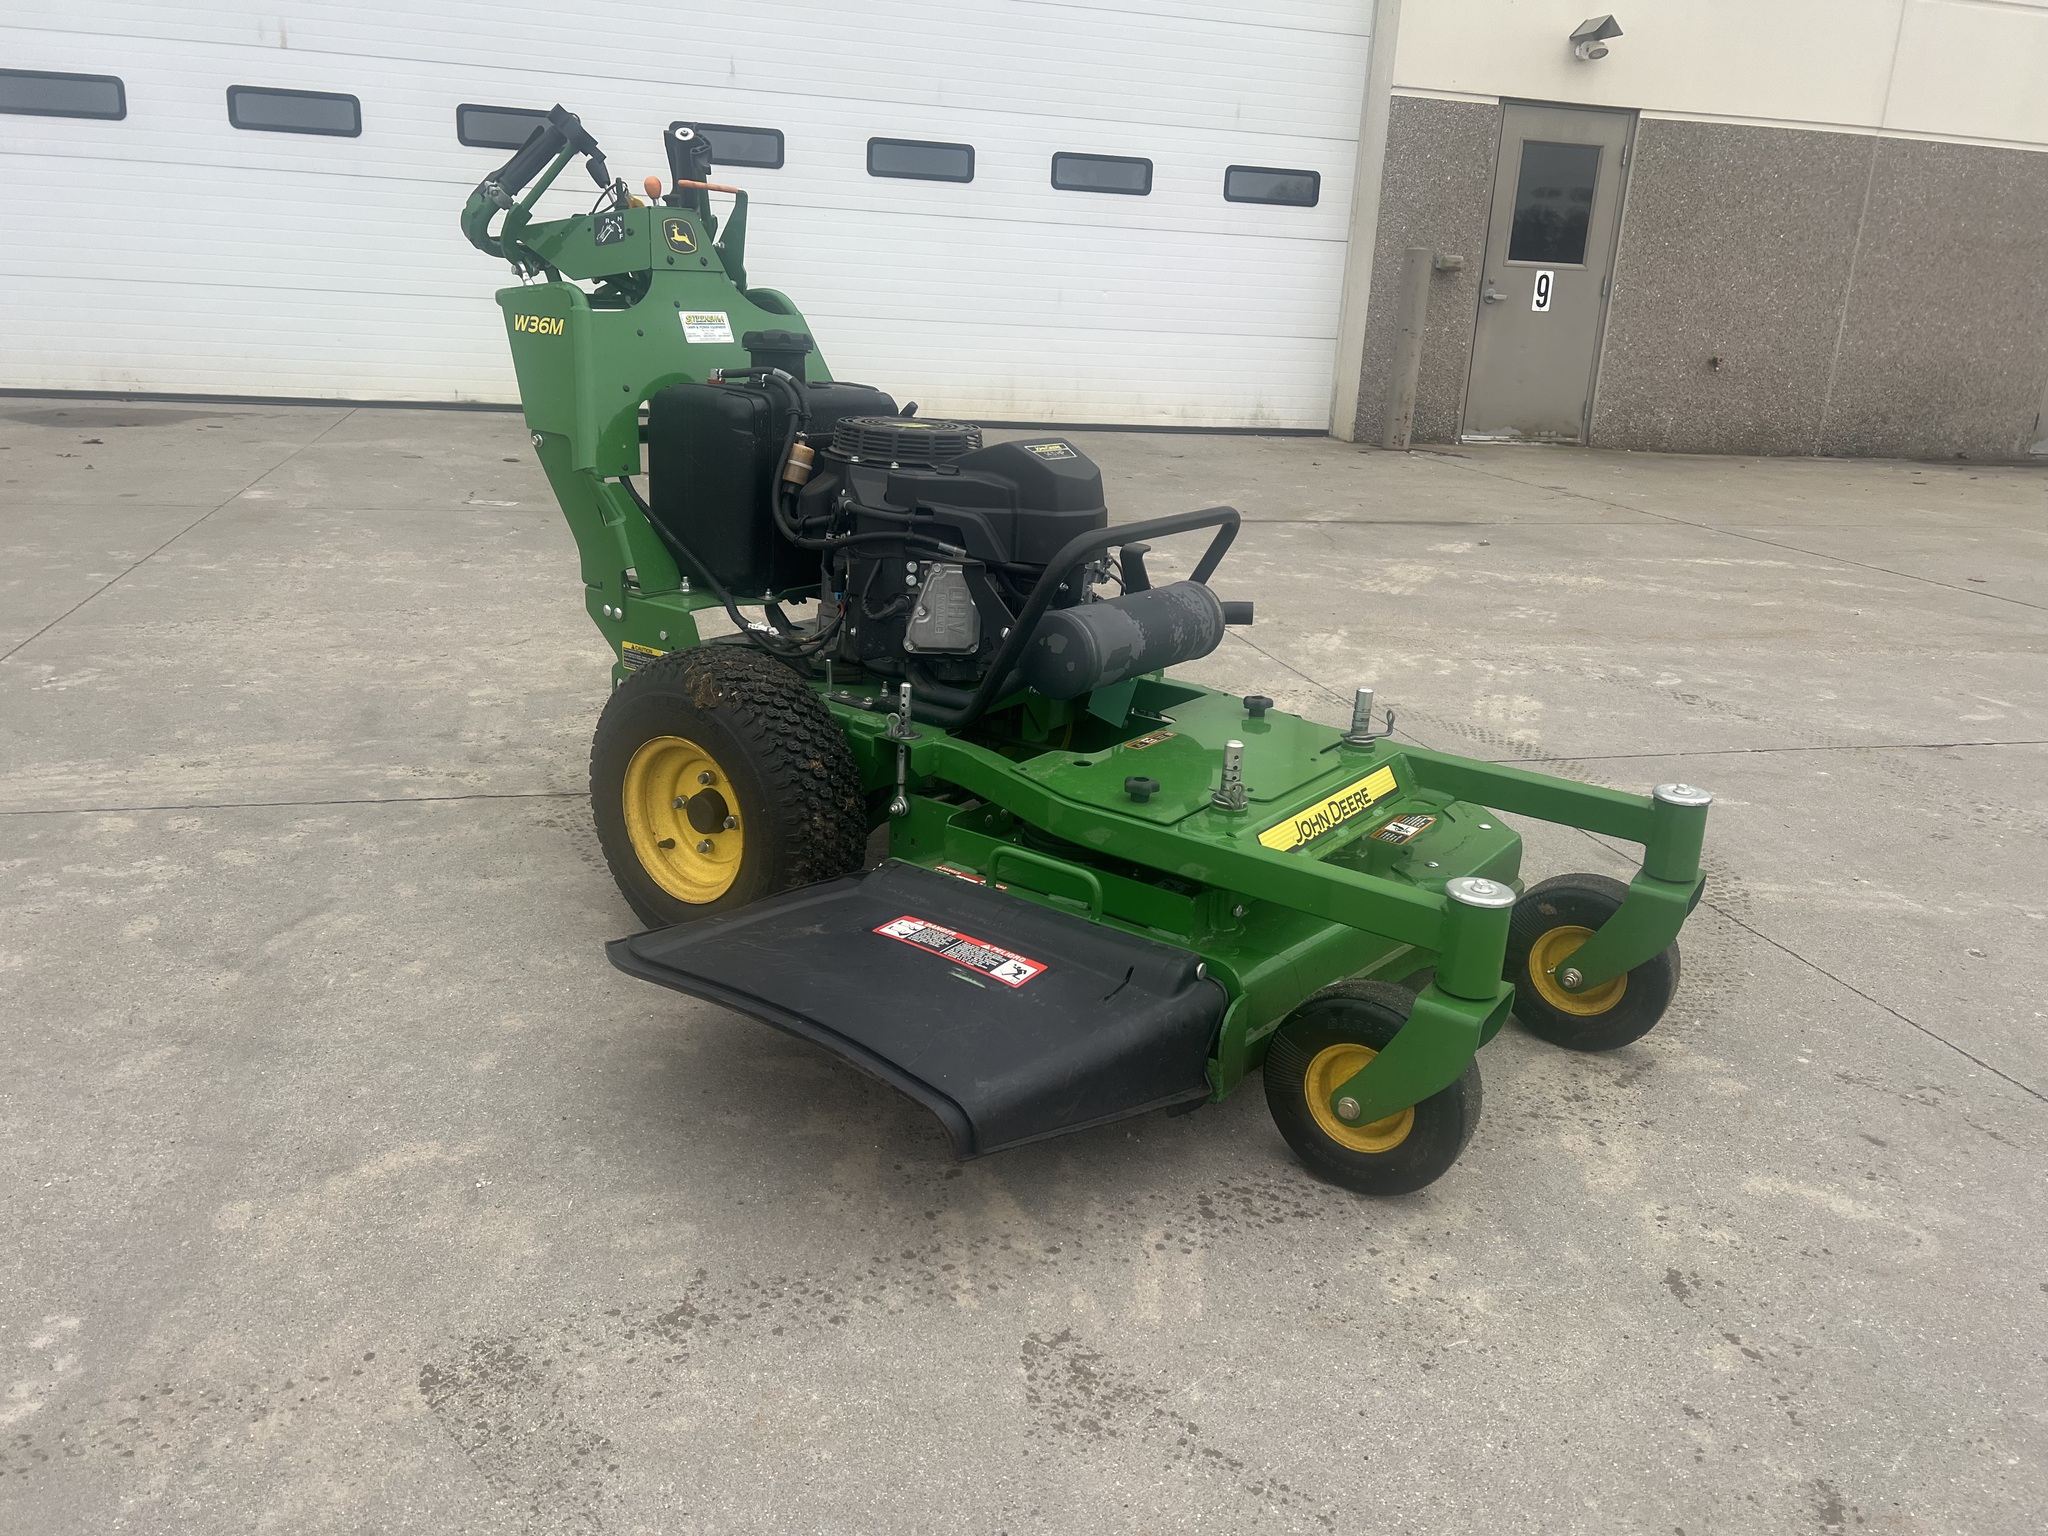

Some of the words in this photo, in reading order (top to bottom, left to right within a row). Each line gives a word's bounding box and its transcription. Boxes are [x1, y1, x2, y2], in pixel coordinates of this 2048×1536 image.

[1536, 274, 1550, 308] 9
[514, 313, 565, 336] W36M
[635, 645, 653, 654] CAUTION
[1294, 809, 1332, 844] JOHN
[924, 922, 957, 936] DANGER
[991, 946, 1027, 963] PELIGRO
